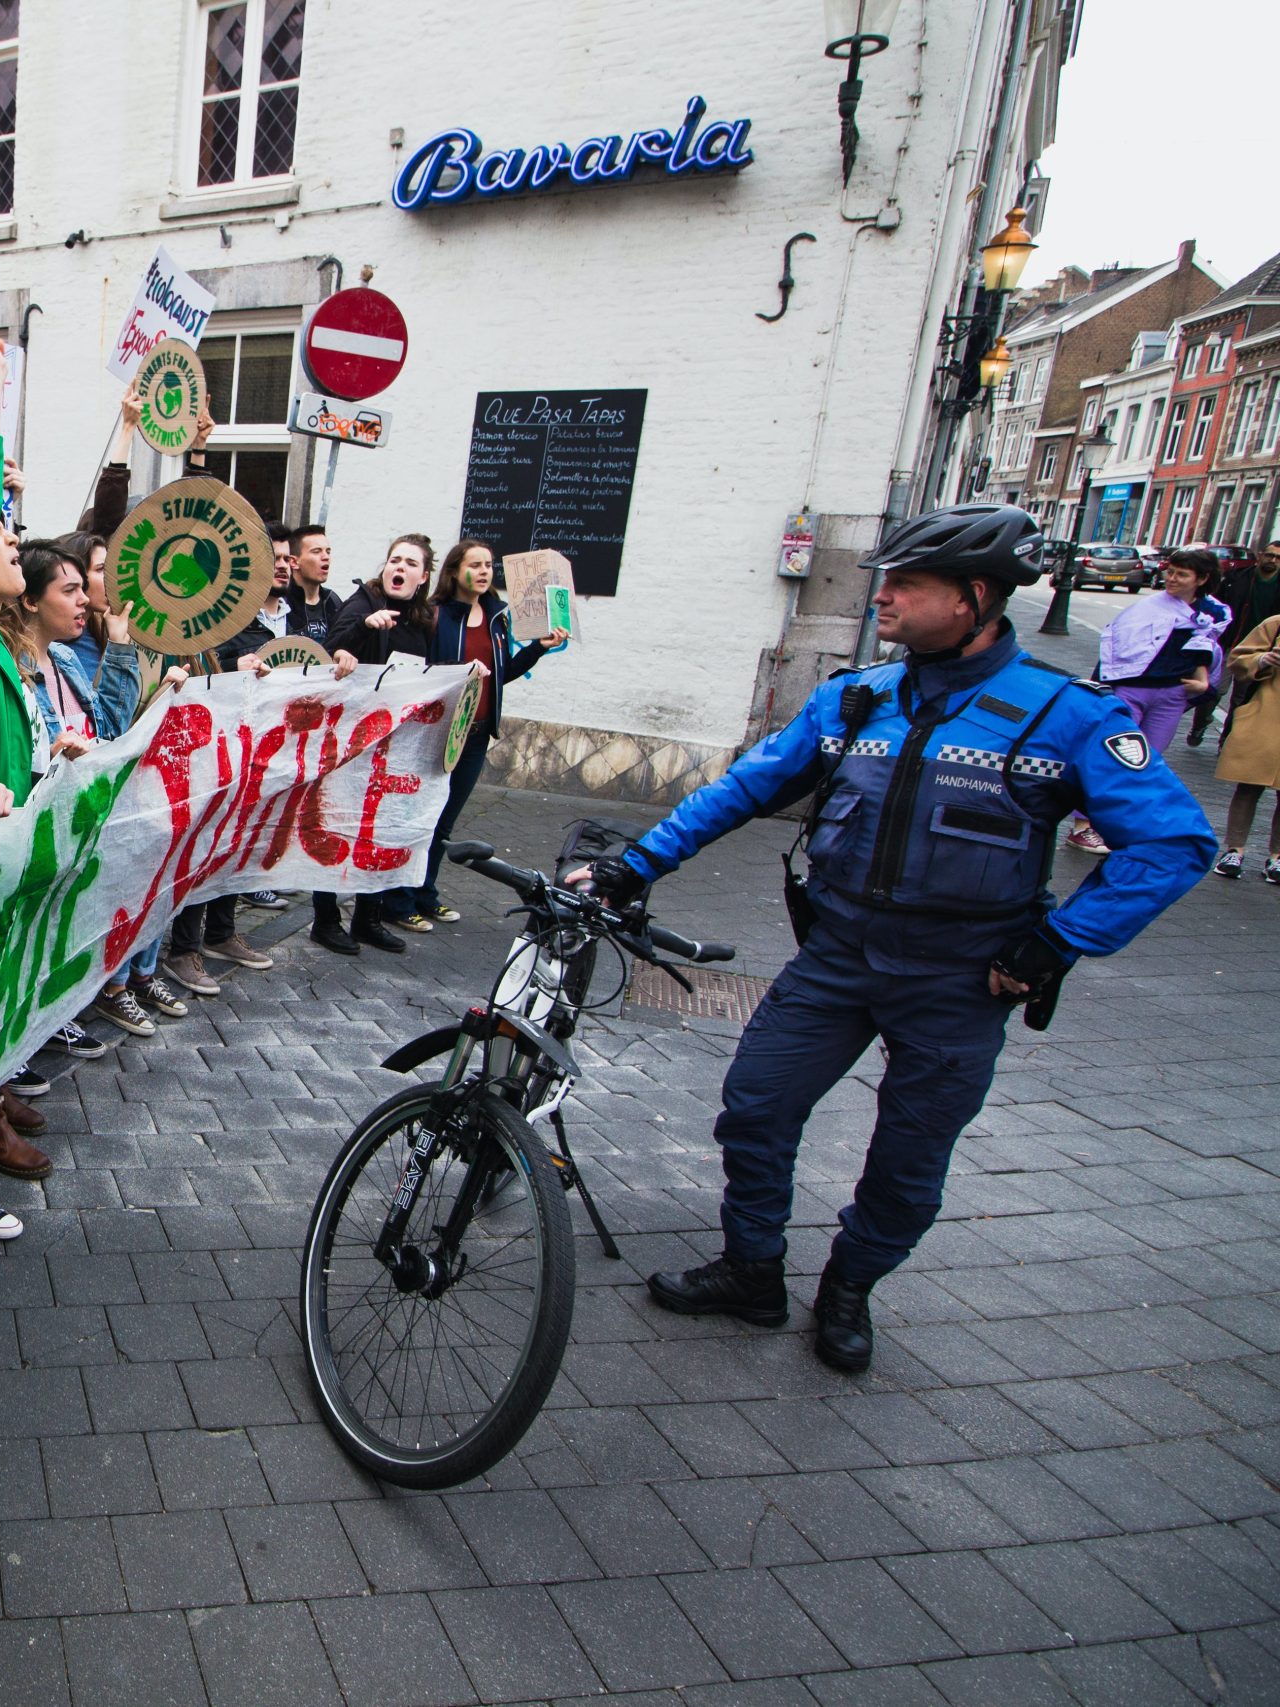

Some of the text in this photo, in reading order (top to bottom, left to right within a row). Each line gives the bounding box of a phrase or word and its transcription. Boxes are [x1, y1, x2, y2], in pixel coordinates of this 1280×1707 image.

[394, 96, 751, 211] Bavaria
[139, 350, 172, 397] STUDENTS
[184, 368, 199, 418] CLIMATE
[484, 396, 626, 424] QUE PASA TAPAS
[162, 498, 243, 543] STUDENTS
[181, 583, 244, 639] CLIMATE
[935, 774, 1002, 795] HANDHAVING
[104, 695, 447, 973] JUSTICE
